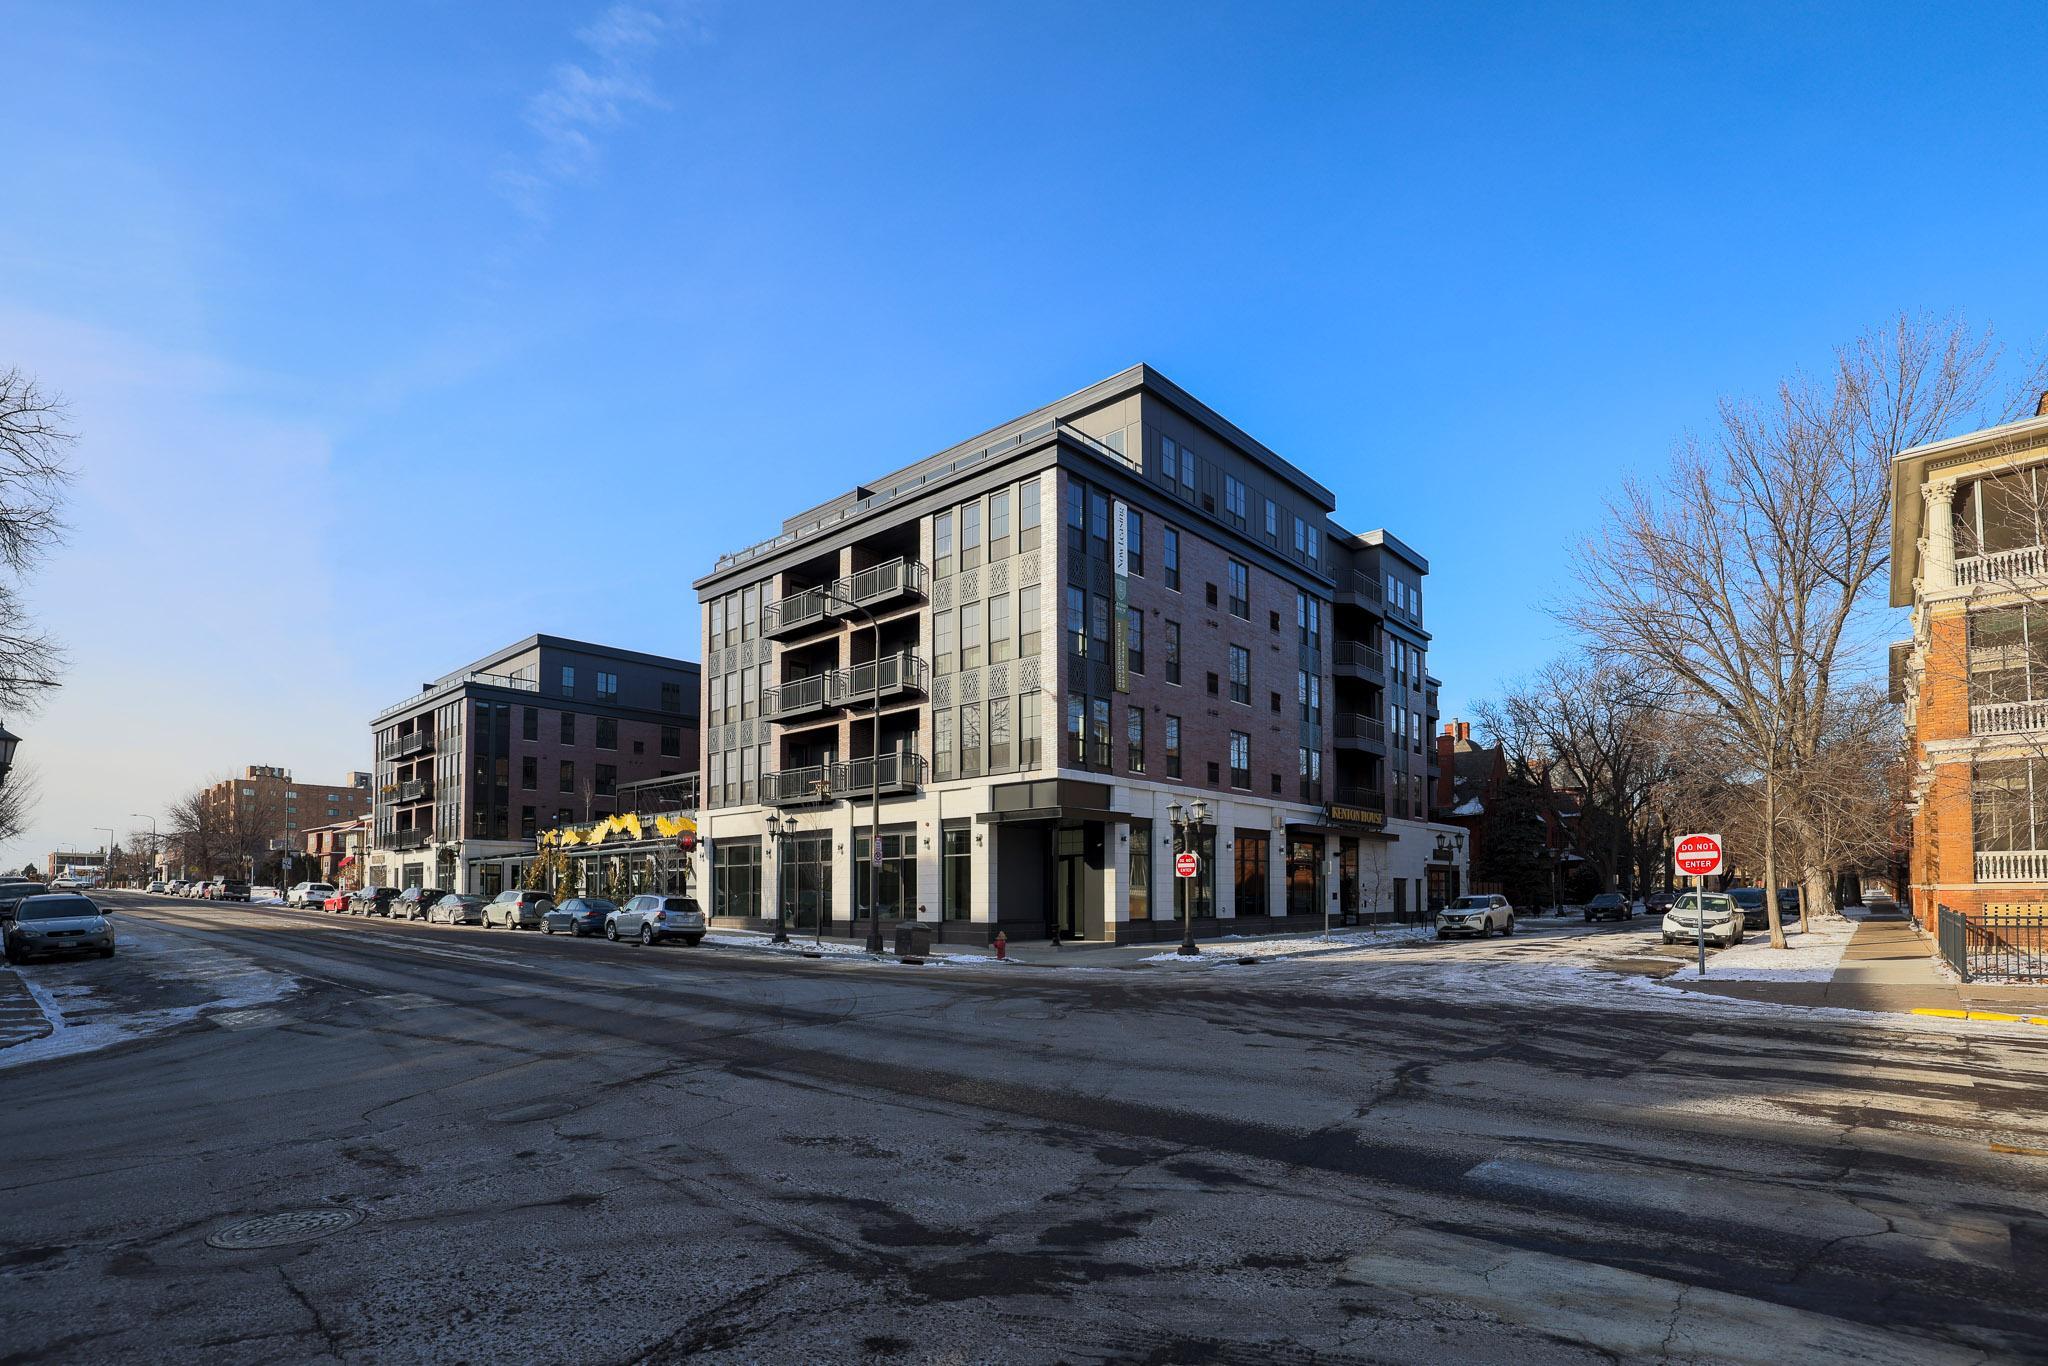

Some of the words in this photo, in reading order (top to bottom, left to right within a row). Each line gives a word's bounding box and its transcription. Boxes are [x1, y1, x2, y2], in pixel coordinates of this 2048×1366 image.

[1332, 807, 1360, 820] KENTON
[1361, 811, 1383, 824] HOUSE
[1685, 860, 1711, 868] ENTER
